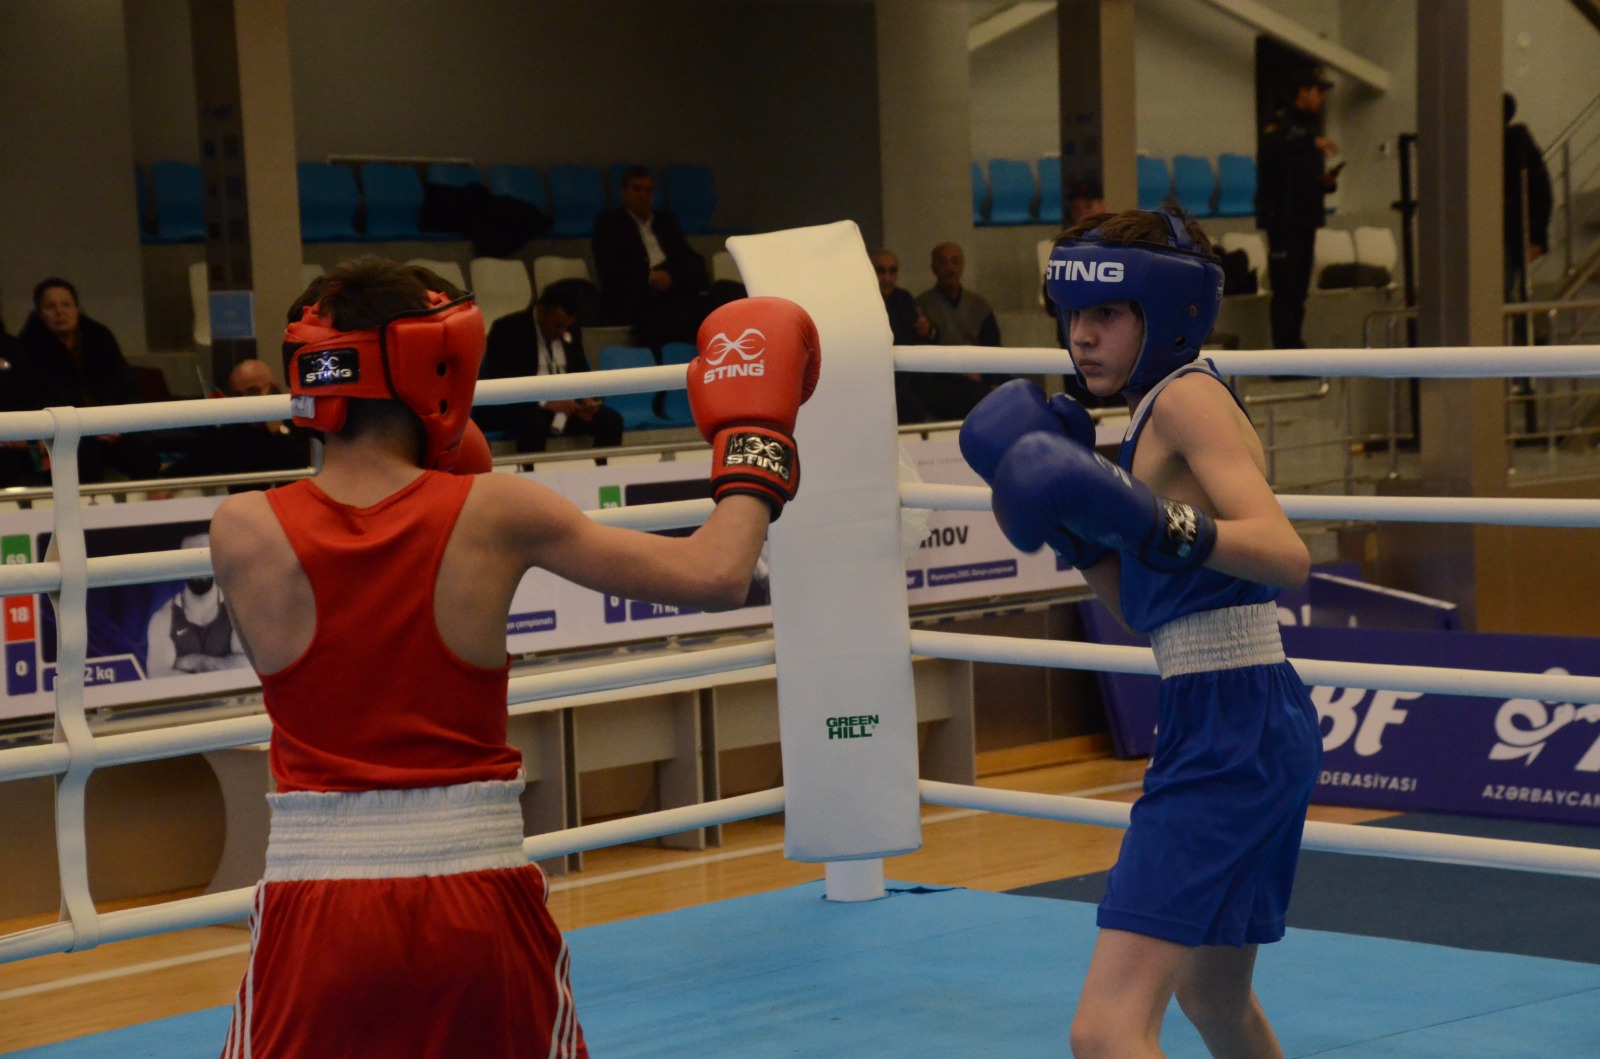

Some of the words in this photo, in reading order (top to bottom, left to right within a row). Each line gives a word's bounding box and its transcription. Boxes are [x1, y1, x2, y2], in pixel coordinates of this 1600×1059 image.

[305, 368, 352, 383] STING
[703, 363, 765, 384] STING
[726, 453, 790, 480] STING
[919, 525, 969, 549] nov
[10, 608, 29, 623] 18
[16, 661, 28, 676] 0
[826, 715, 879, 728] GREEN
[829, 726, 872, 740] HILL
